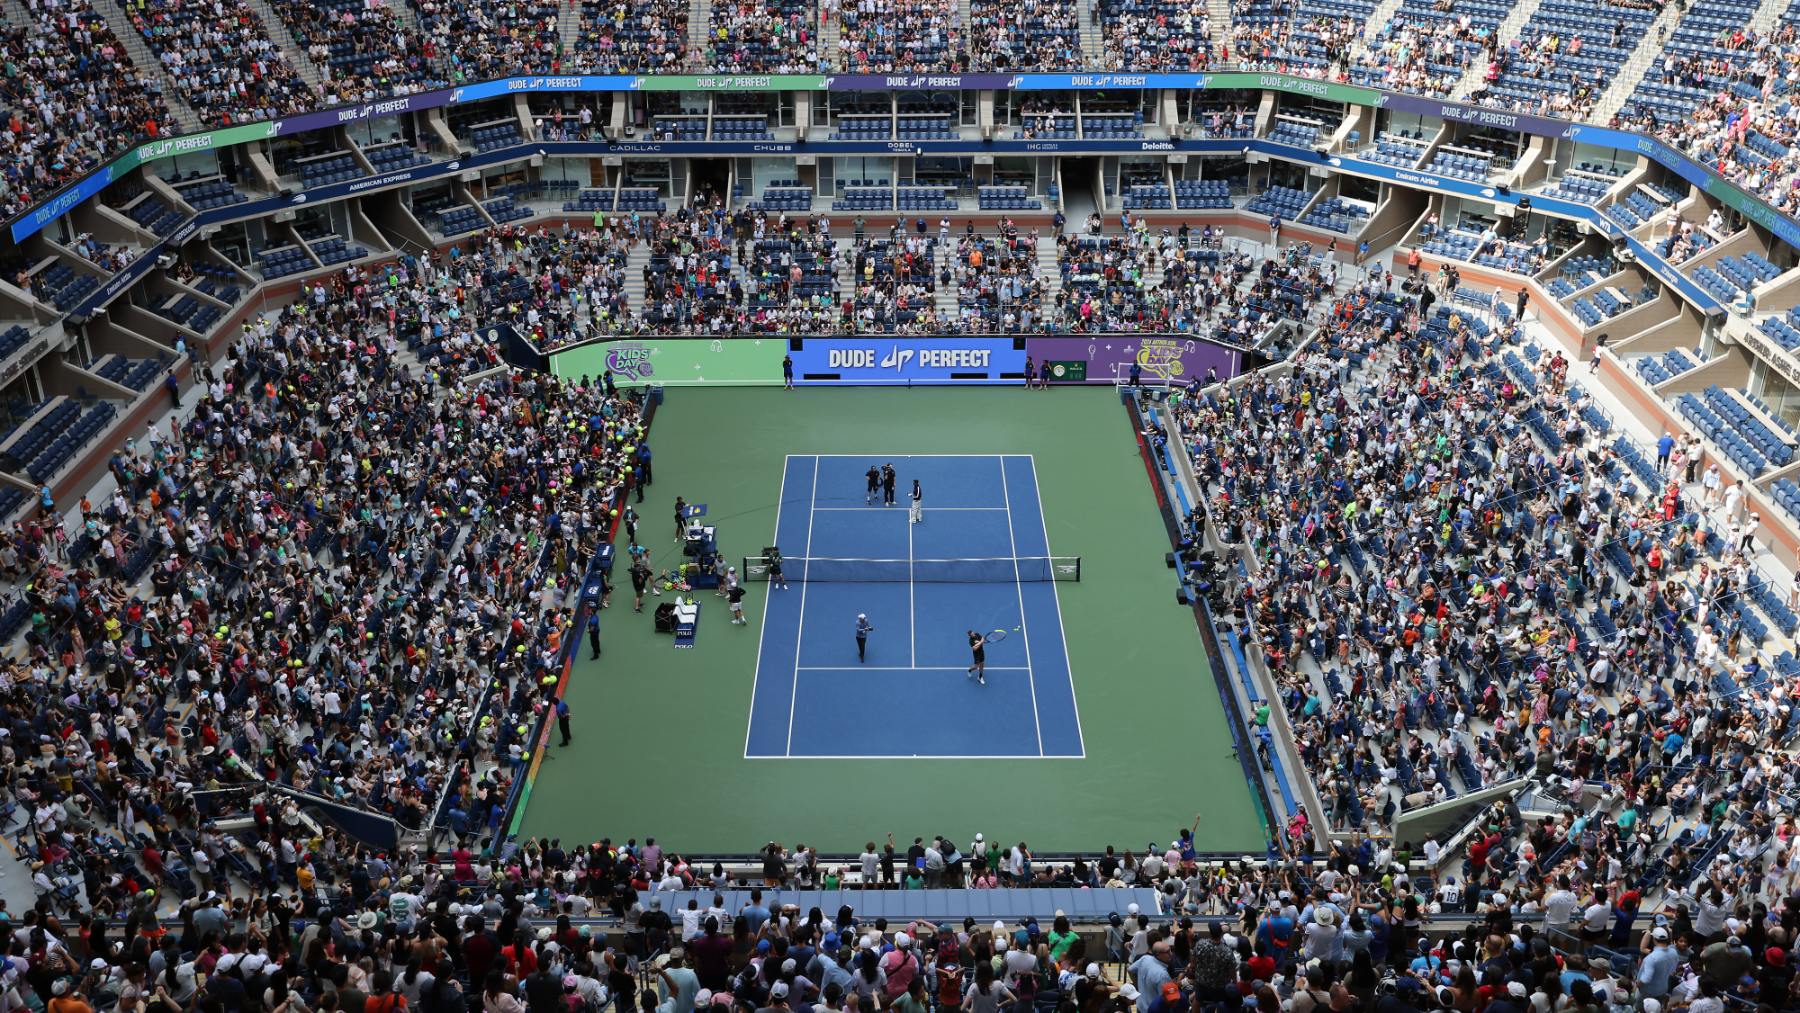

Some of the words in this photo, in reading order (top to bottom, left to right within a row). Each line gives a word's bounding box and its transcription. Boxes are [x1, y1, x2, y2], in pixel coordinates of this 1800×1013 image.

[508, 78, 527, 90] DUDE
[546, 77, 582, 88] PERFECT
[697, 78, 716, 88] DUDE
[735, 76, 771, 87] PERFECT
[886, 76, 908, 87] DUDE
[928, 76, 962, 87] PERFECT
[1072, 76, 1094, 86] DUDE
[1114, 76, 1147, 86] PERFECT
[1260, 76, 1282, 87] DUDE
[1298, 81, 1329, 96] PERFECT
[338, 109, 358, 122] DUDE
[375, 98, 410, 114] PERFECT
[1441, 106, 1462, 118] DUDE
[1479, 111, 1516, 127] PERFECT
[176, 135, 212, 150] PERFECT
[610, 144, 661, 152] CADILLAC
[350, 178, 382, 191] AMERICAN
[383, 172, 412, 184] EXPRESS
[1396, 172, 1419, 183] Emirates
[36, 206, 51, 225] DUDE
[615, 349, 650, 362] KIDS
[829, 350, 875, 368] DUDE
[920, 349, 991, 368] PERFECT
[616, 359, 638, 370] DAY
[1446, 892, 1456, 902] 10
